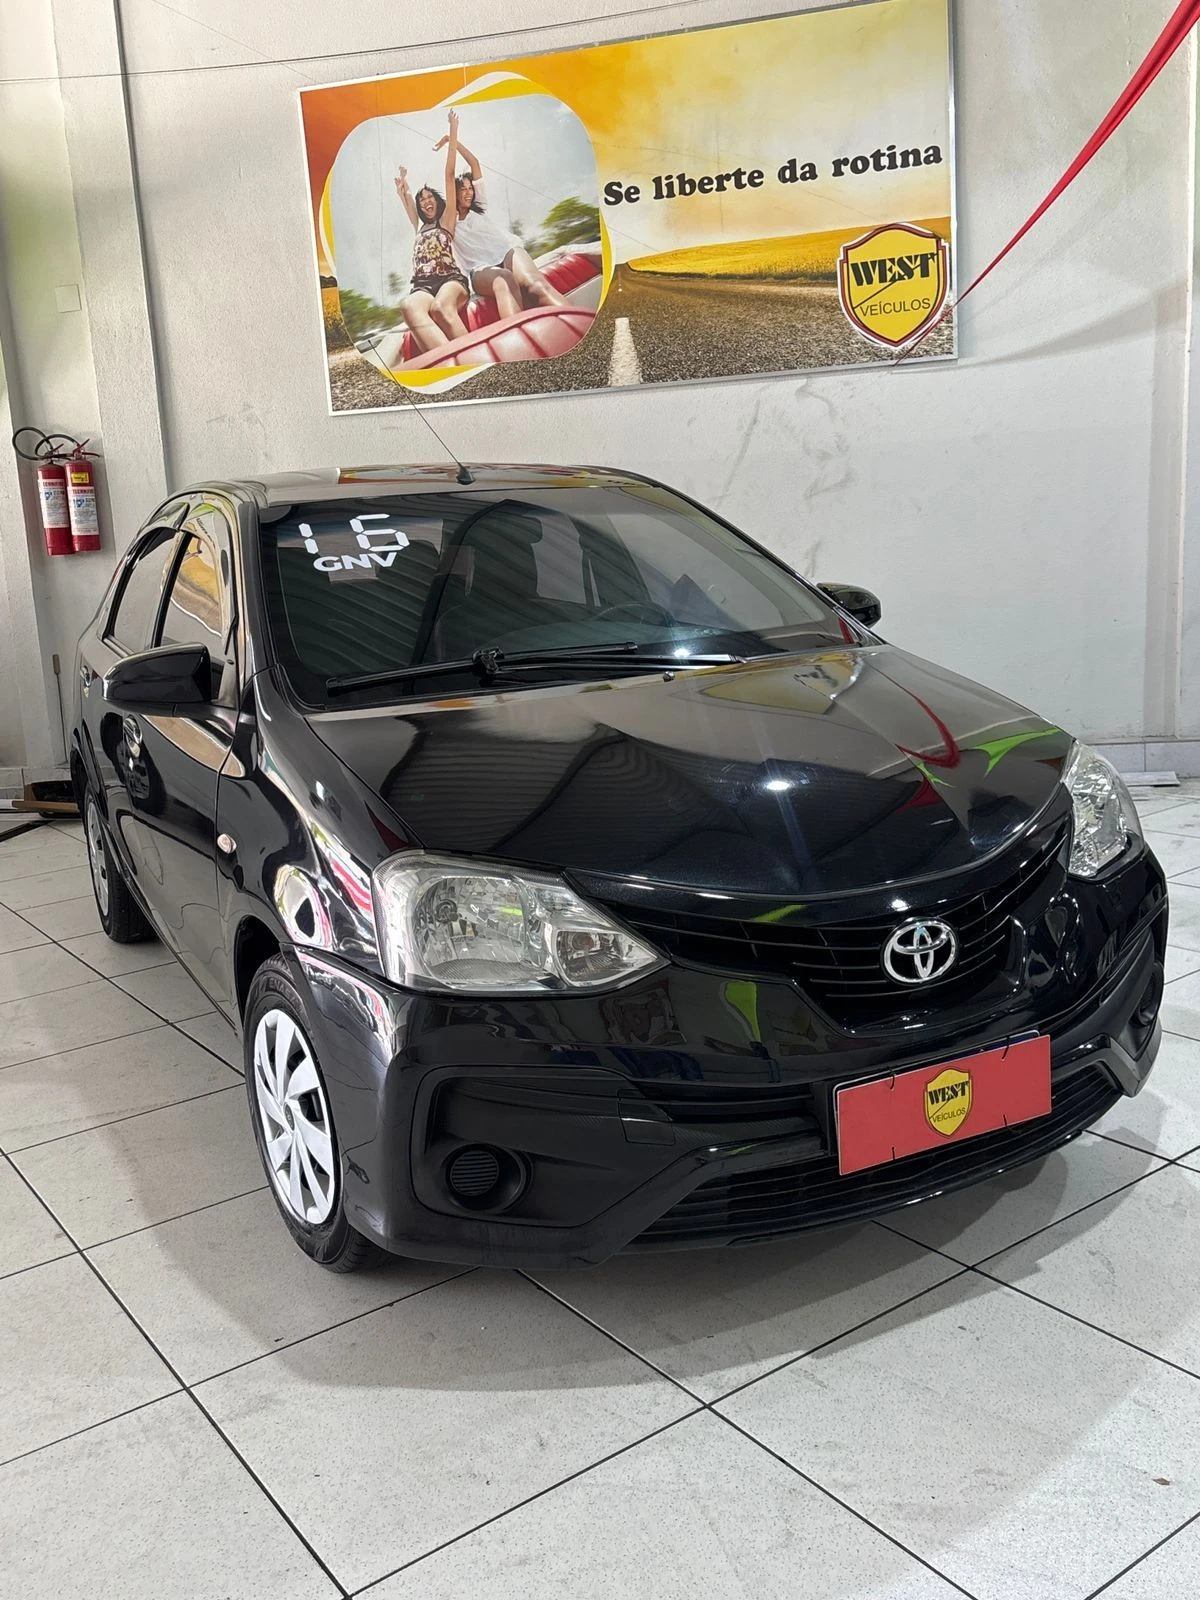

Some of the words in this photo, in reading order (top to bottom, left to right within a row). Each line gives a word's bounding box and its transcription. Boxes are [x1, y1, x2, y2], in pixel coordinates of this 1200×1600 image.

[603, 180, 641, 206] Se
[653, 168, 764, 200] liberte
[777, 158, 818, 184] da
[831, 145, 942, 177] rotina
[850, 252, 937, 286] WEST
[859, 298, 932, 317] VEÍCULOS
[313, 551, 398, 572] GNV
[928, 1080, 970, 1105] WEST
[932, 1107, 967, 1123] VEÍCULOS
